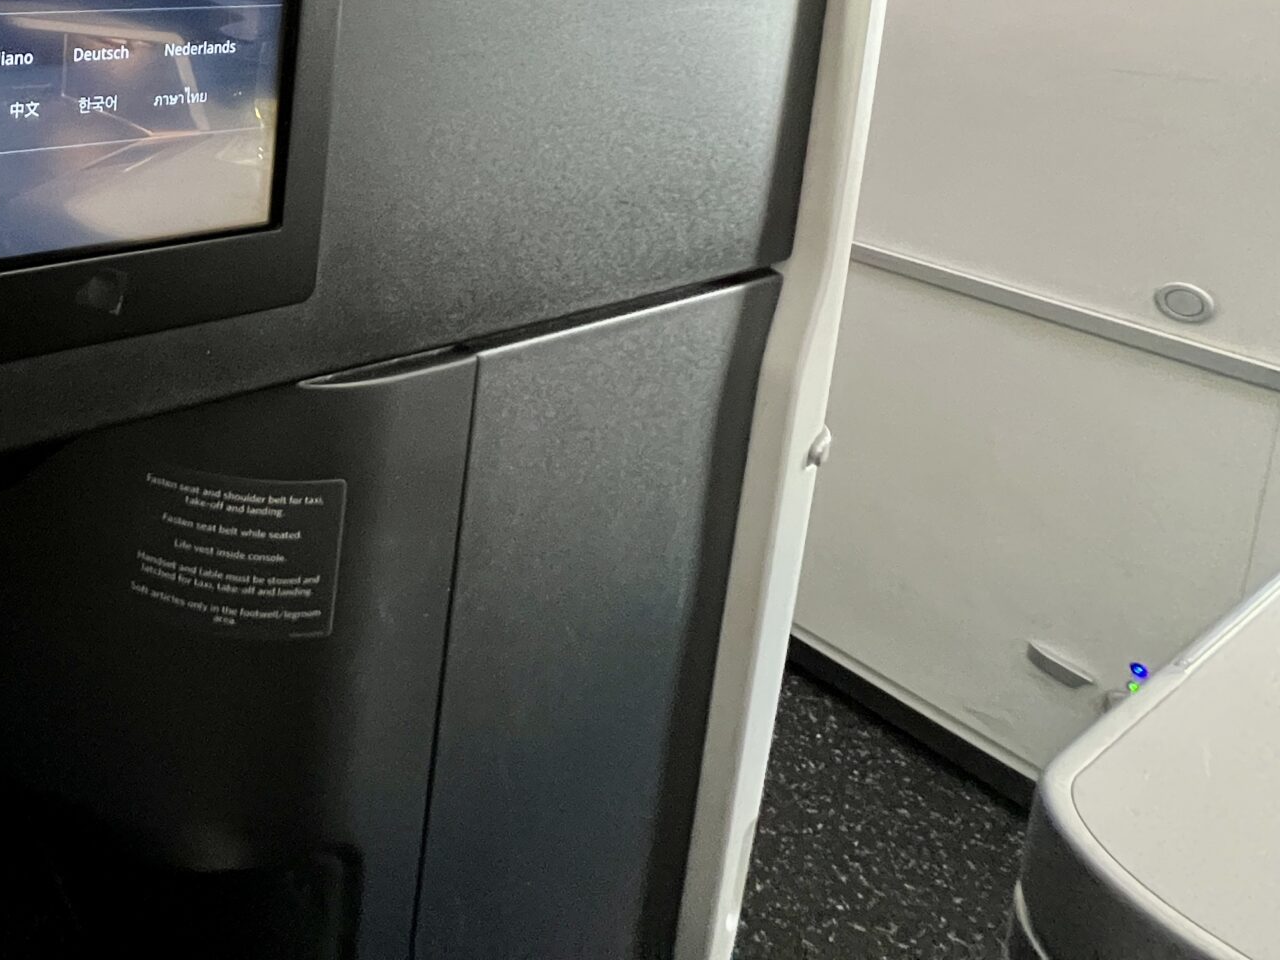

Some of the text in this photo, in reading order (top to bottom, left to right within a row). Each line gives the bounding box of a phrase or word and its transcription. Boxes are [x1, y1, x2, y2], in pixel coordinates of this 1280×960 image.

[73, 46, 130, 62] Deutsch
[164, 40, 237, 57] Nederlands
[78, 95, 118, 114] 한국어
[153, 87, 208, 107] ภาษาไทย
[10, 101, 40, 119] 中文
[202, 489, 221, 498] and
[223, 491, 266, 503] shoulder
[268, 495, 287, 505] belt
[289, 496, 302, 505] for
[226, 504, 245, 513] and
[196, 523, 216, 532] seat
[218, 524, 238, 536] belt
[241, 528, 266, 538] while
[194, 546, 214, 555] vest
[216, 549, 246, 560] inside
[179, 565, 197, 575] and
[225, 574, 250, 583] must
[252, 575, 265, 584] be
[303, 575, 320, 585] and
[257, 587, 276, 596] and
[187, 601, 208, 612] only
[210, 604, 220, 612] in
[221, 606, 238, 616] the
